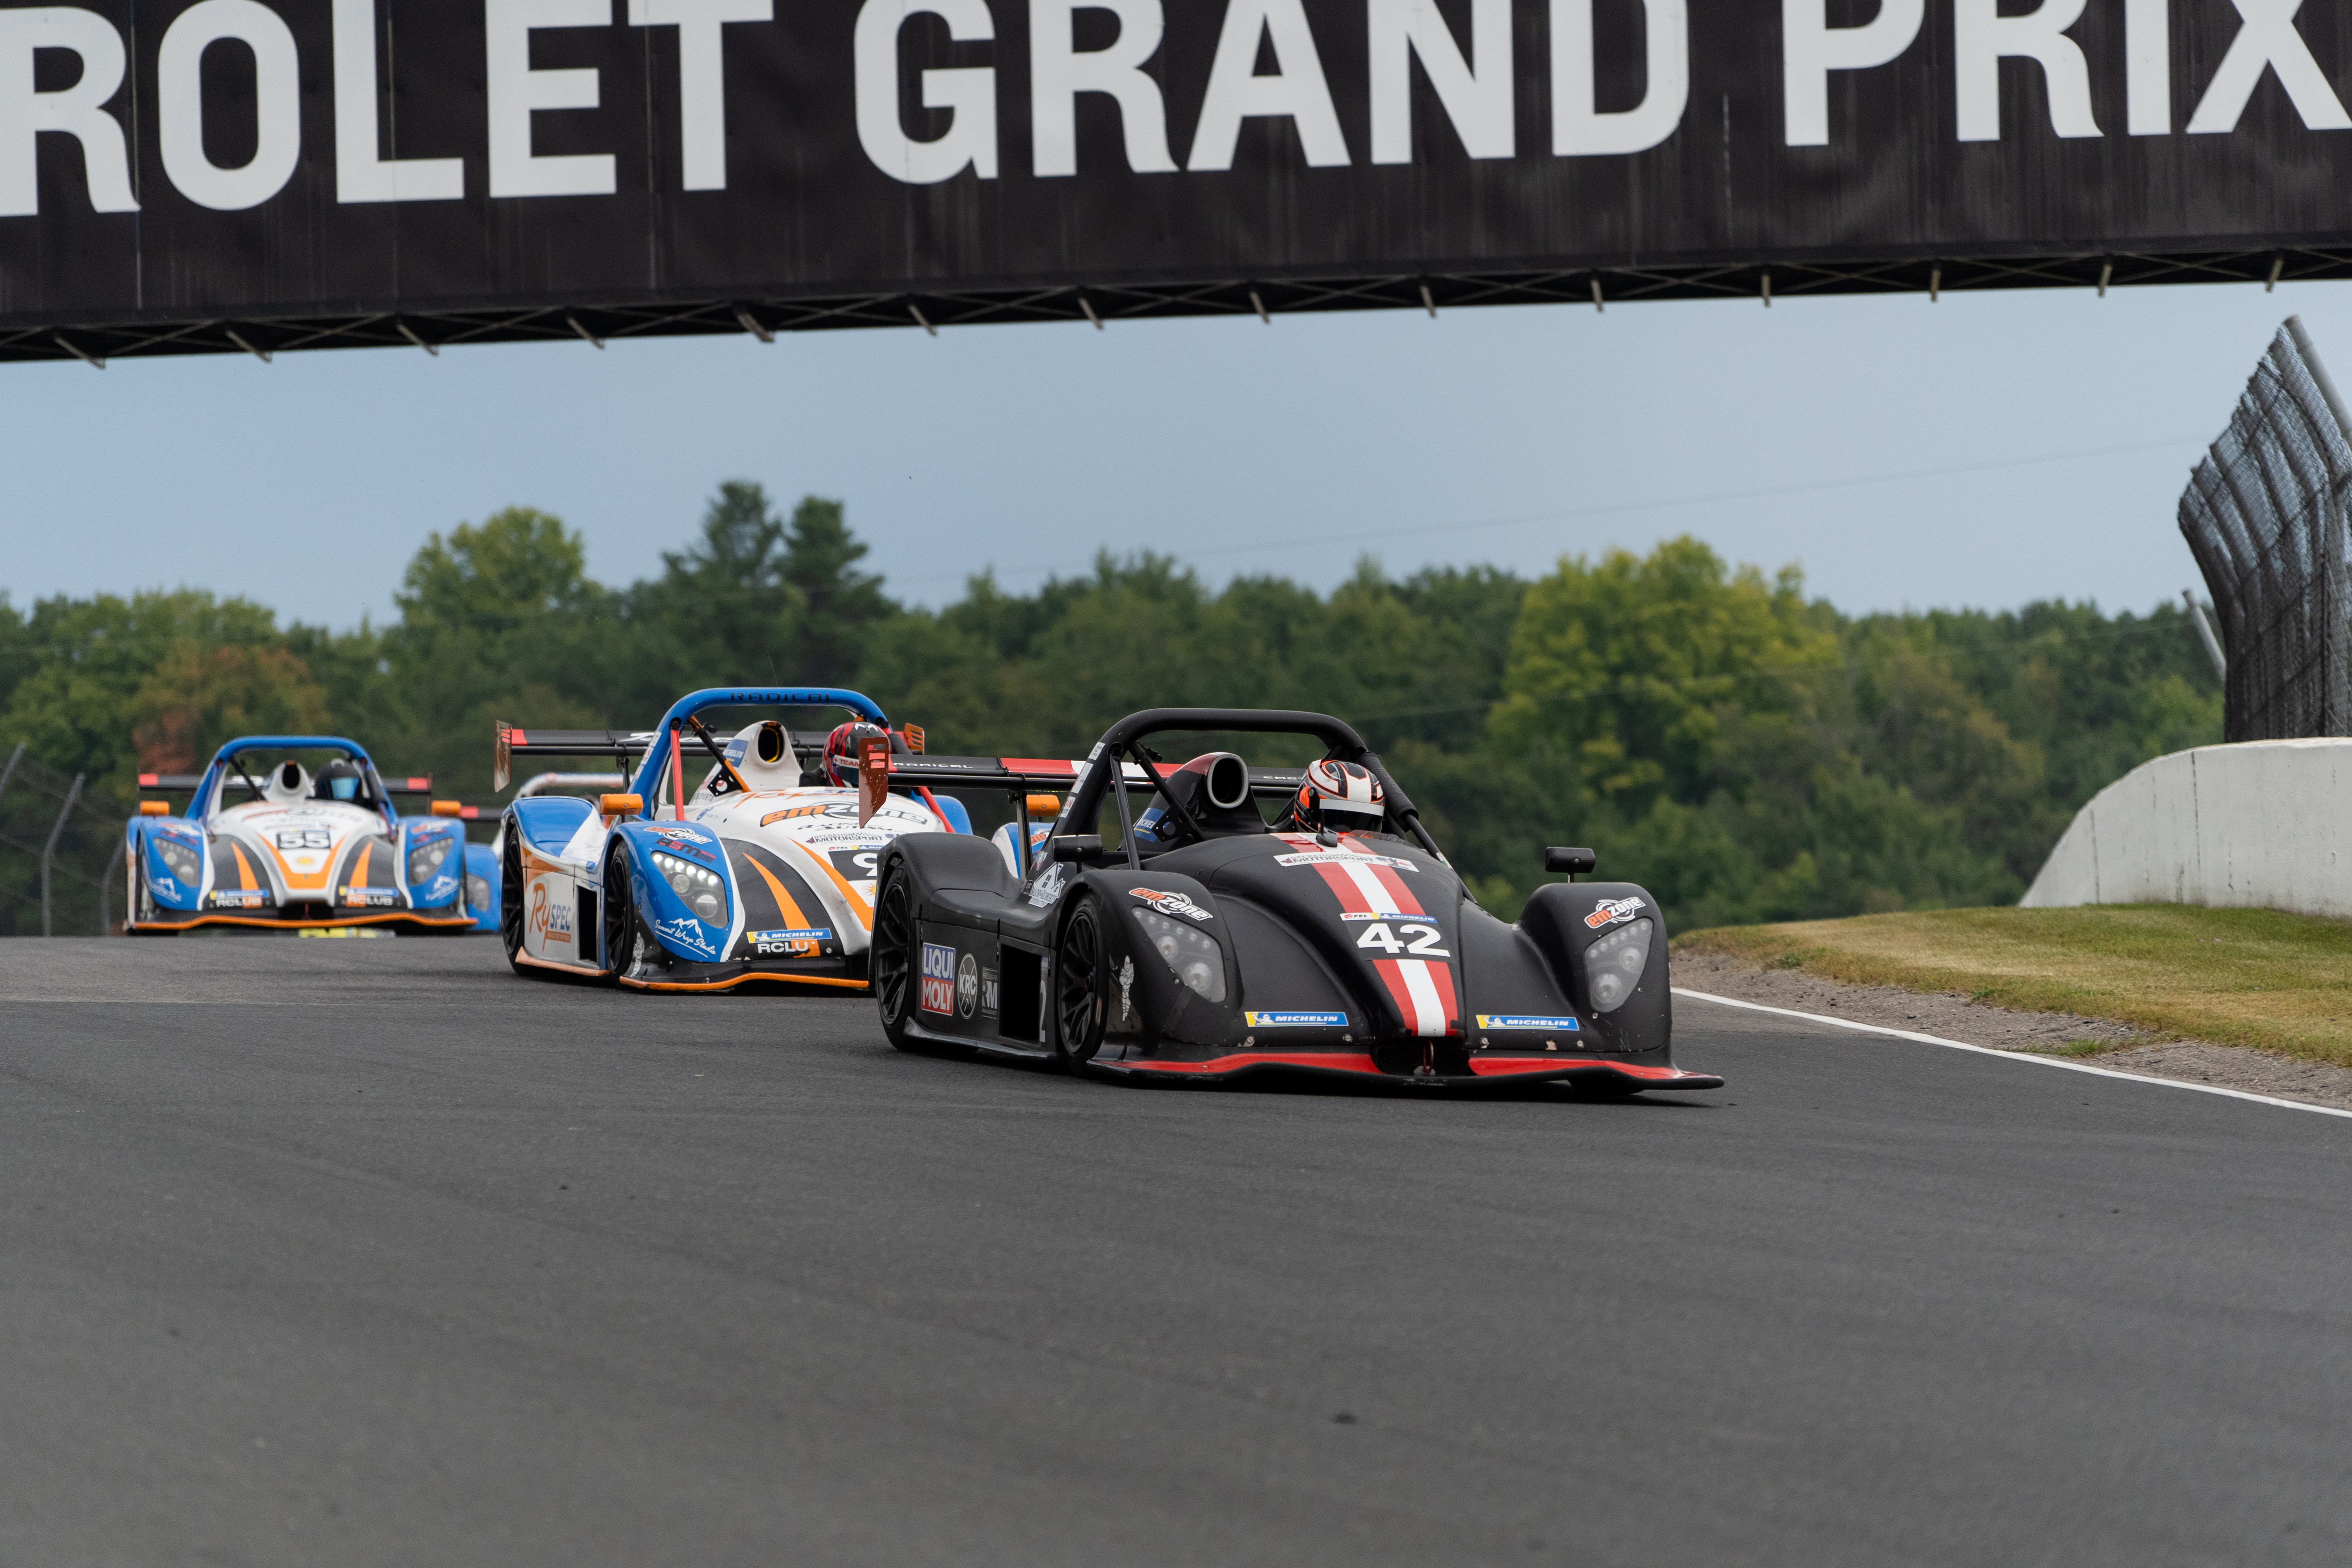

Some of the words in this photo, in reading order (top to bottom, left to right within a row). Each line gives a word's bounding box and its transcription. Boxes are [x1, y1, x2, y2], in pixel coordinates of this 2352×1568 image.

[0, 0, 773, 216] ROLET
[854, 0, 1690, 184] GRAND
[1782, 0, 2352, 146] PRIX
[730, 693, 831, 701] RADICAL
[280, 833, 330, 849] 55
[1131, 889, 1209, 919] emzone
[1587, 899, 1642, 927] emzone
[655, 920, 675, 934] Summit
[694, 938, 716, 955] Studio
[757, 942, 813, 953] RCLU
[1356, 923, 1451, 957] 42
[923, 947, 954, 979] LIQUI
[923, 979, 953, 1010] MOLY
[959, 974, 976, 996] KRC
